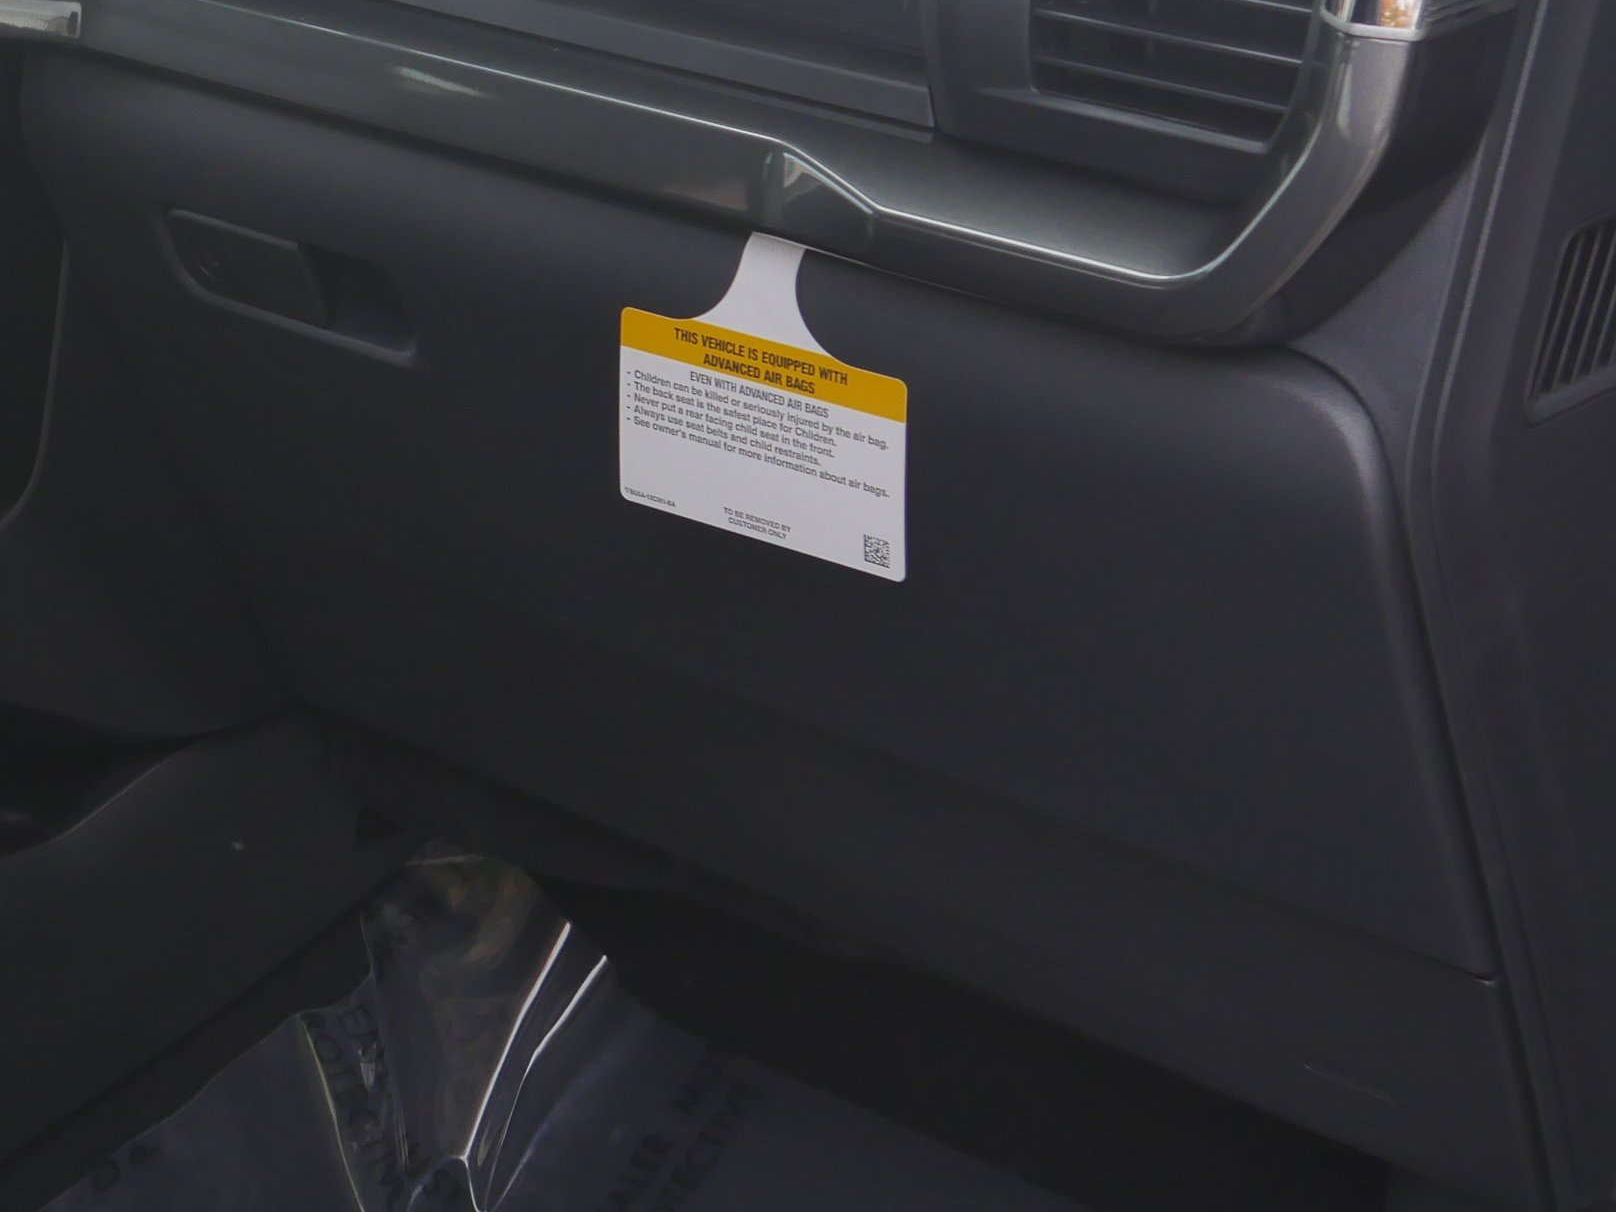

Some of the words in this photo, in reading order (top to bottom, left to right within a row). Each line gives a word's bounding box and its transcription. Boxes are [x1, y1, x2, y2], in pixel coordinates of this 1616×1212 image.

[674, 327, 698, 345] THIS
[701, 334, 745, 357] VEHICLE
[748, 347, 758, 361] IS
[761, 351, 815, 376] EQUIPPED
[818, 366, 848, 386] WITH
[703, 353, 760, 379] ADVANCED
[763, 369, 782, 385] AIR
[785, 375, 815, 394] BAGS
[633, 380, 651, 394] The
[652, 386, 674, 400] back
[675, 394, 694, 406] seat
[696, 398, 704, 409] is
[706, 402, 721, 414] the
[723, 408, 750, 422] safest
[752, 416, 777, 429] place
[779, 422, 793, 433] for
[634, 369, 671, 388] Children
[673, 382, 689, 393] can
[691, 385, 703, 397] be
[704, 389, 729, 404] killed
[730, 398, 741, 407] or
[743, 402, 785, 421] seriously
[787, 412, 819, 430] injured
[821, 422, 834, 435] by
[835, 426, 851, 439] the
[852, 432, 866, 442] air
[634, 392, 660, 407] Never
[661, 402, 676, 413] put
[678, 407, 684, 415] a
[685, 409, 704, 420] rear
[705, 413, 733, 431] facing
[735, 423, 758, 436] child
[759, 430, 779, 442] seat
[781, 434, 790, 445] in
[792, 438, 807, 450] the
[690, 371, 712, 386] EVEN
[714, 377, 737, 393] WITH
[739, 385, 785, 406] ADVANCED
[787, 398, 802, 411] AIR
[805, 402, 829, 418] BAGS
[633, 404, 665, 421] Always
[667, 415, 684, 426] use
[685, 421, 704, 433] seat
[706, 425, 728, 439] belts
[730, 433, 748, 445] and
[749, 439, 772, 452] child
[633, 415, 651, 428] See
[652, 423, 687, 439] owner's
[688, 433, 721, 449] manual
[723, 441, 737, 453] for
[738, 447, 762, 461] more
[764, 453, 817, 477] information
[819, 471, 847, 485] about
[848, 479, 861, 489] air
